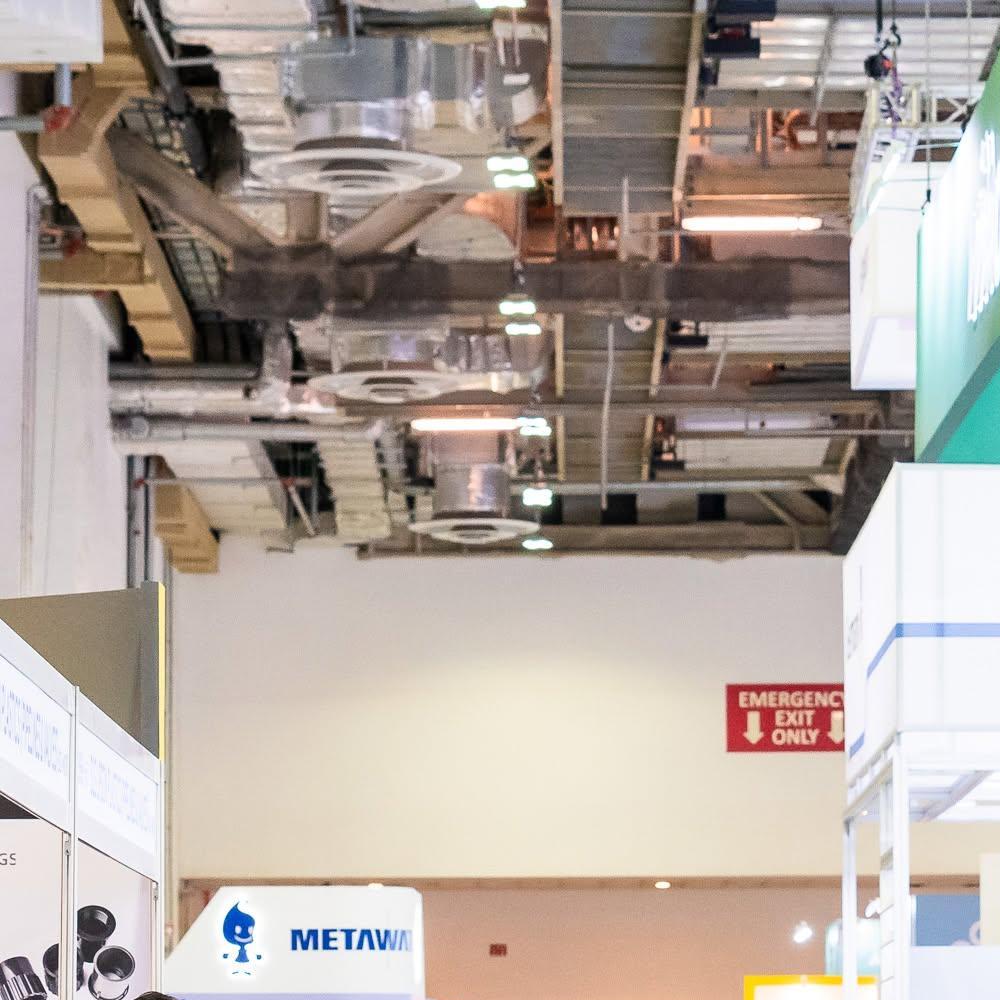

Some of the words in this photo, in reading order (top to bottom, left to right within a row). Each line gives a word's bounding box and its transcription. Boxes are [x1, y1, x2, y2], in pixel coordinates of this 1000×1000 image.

[739, 691, 844, 708] EMERGENC
[775, 710, 815, 727] EXIT
[771, 729, 820, 745] ONLY
